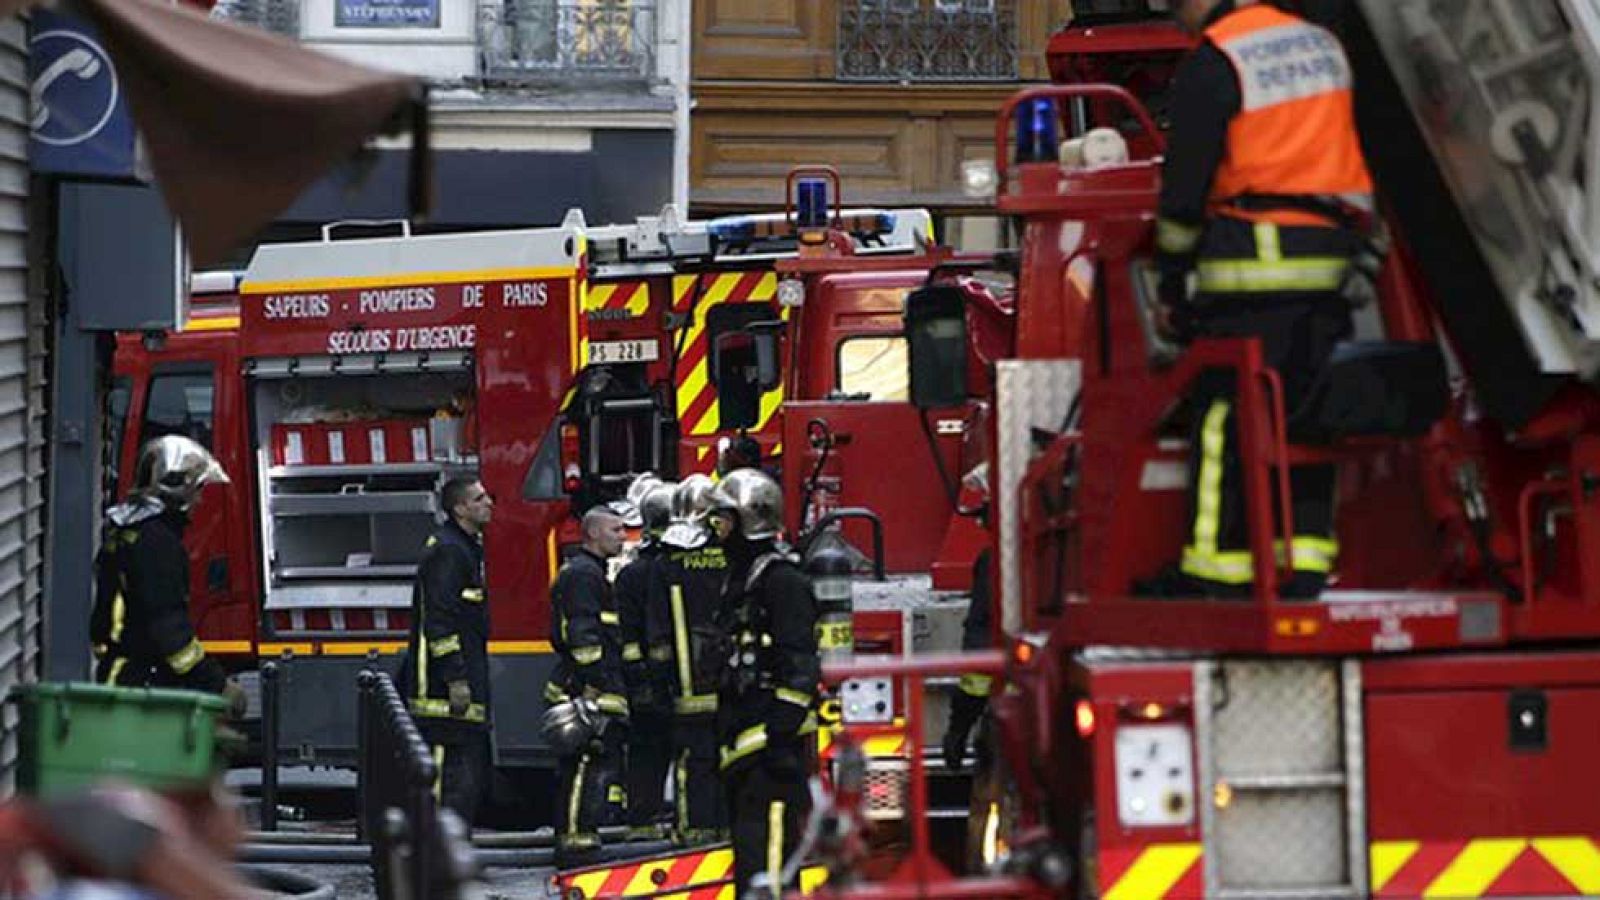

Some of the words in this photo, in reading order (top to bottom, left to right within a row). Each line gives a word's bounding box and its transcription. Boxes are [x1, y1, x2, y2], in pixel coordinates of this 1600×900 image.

[263, 295, 331, 319] SAPEURS
[359, 288, 436, 313] POMPIERS
[462, 285, 484, 308] DE
[503, 282, 548, 307] PARIS
[327, 330, 391, 354] SECOURS
[396, 324, 476, 350] D'URGENCE
